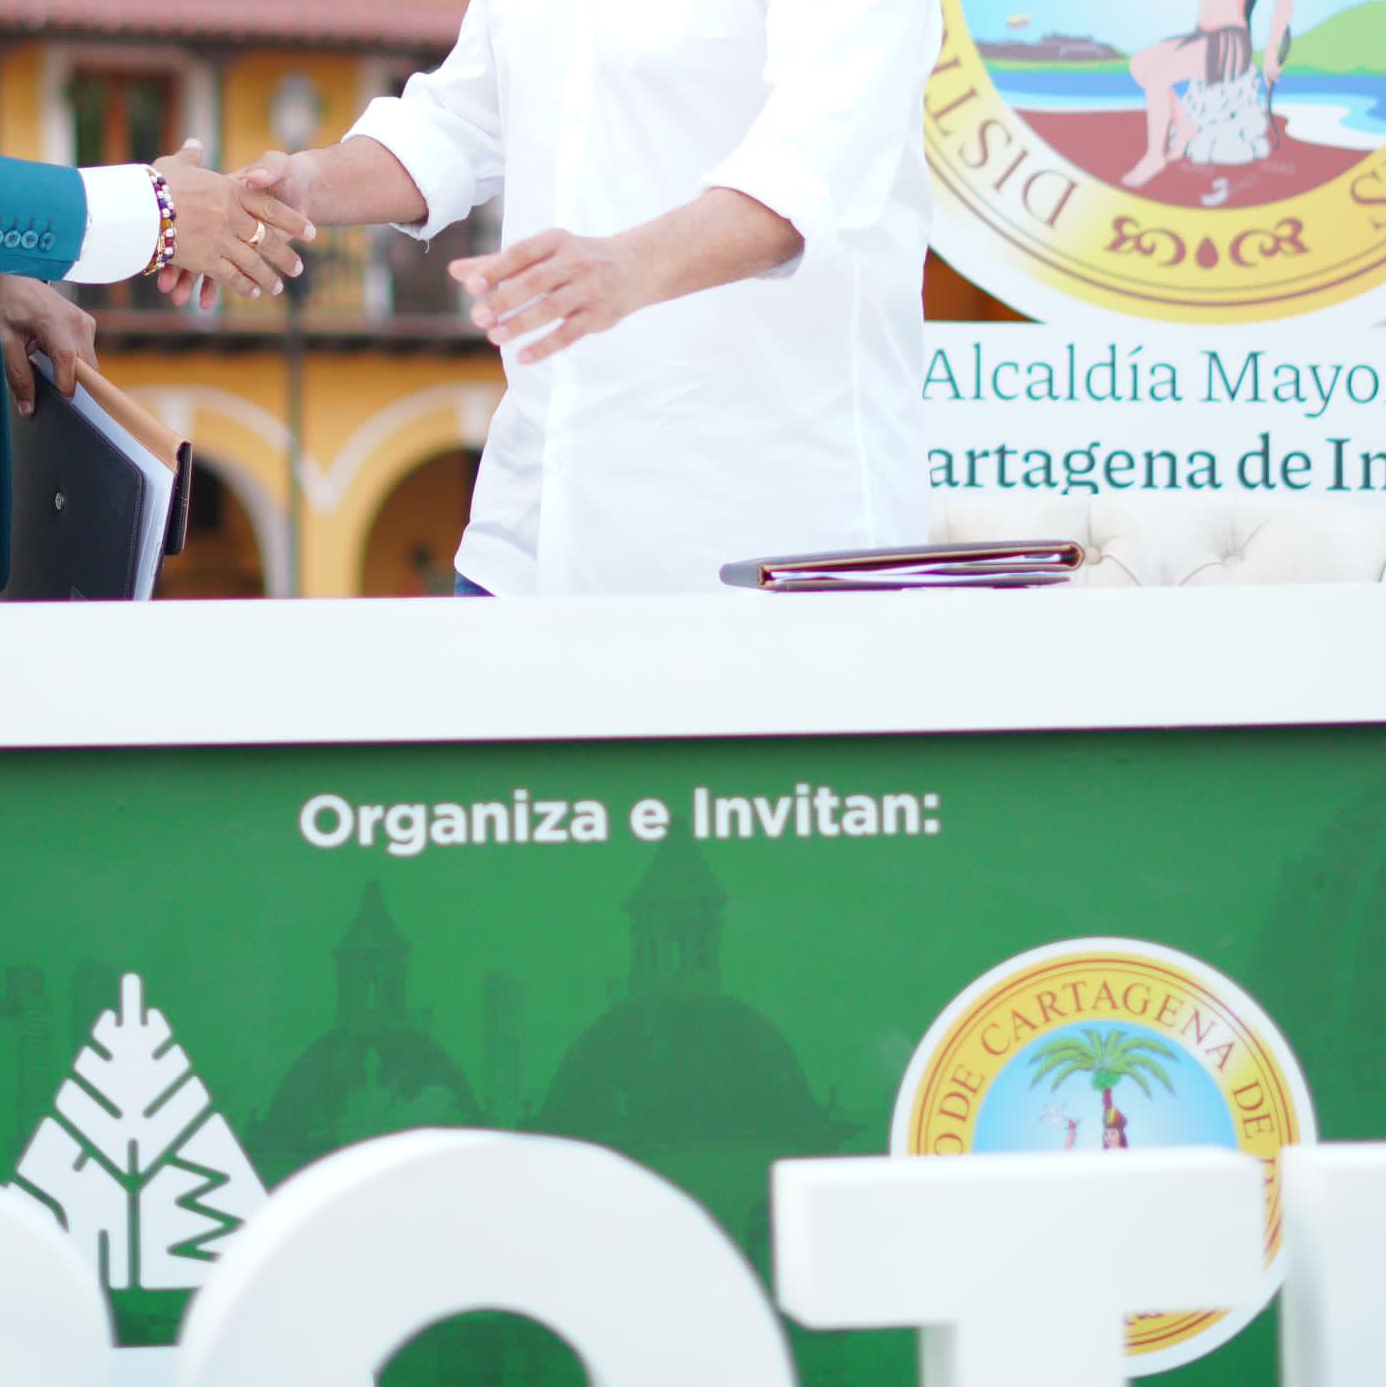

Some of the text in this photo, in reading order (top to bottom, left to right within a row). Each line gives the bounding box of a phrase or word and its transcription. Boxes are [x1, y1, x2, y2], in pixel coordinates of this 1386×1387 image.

[921, 342, 1183, 403] Alcaldía
[926, 440, 1223, 497] artagena
[1236, 431, 1313, 491] de
[298, 783, 941, 856] Organiza e Invitan:
[937, 980, 1276, 1140] DE CARTAGENA DE
